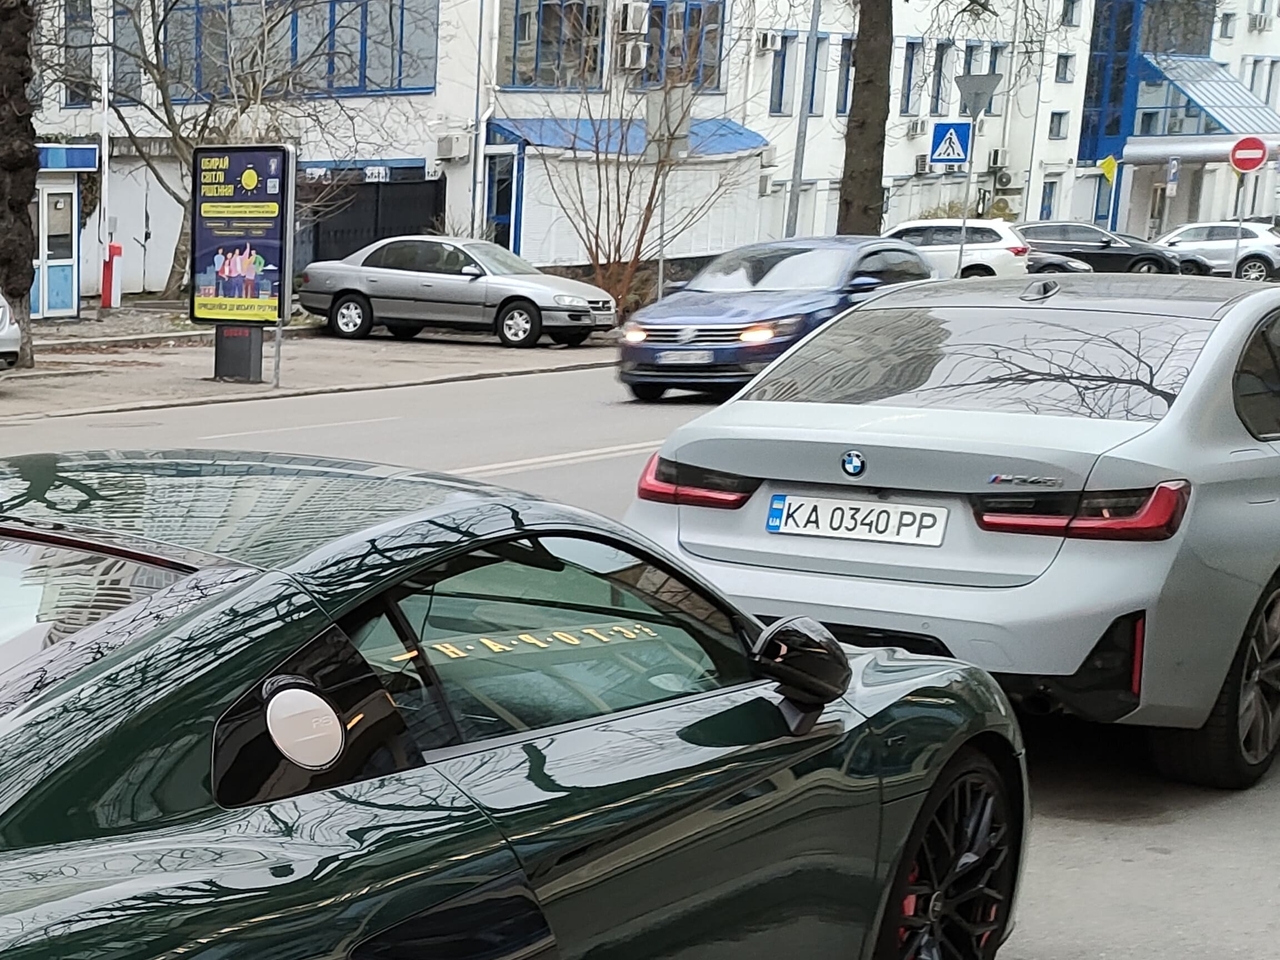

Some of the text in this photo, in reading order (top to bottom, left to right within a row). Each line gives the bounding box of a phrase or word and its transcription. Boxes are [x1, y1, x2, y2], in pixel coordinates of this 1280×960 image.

[769, 517, 781, 527] UA
[784, 503, 937, 538] KA 0340 PP
